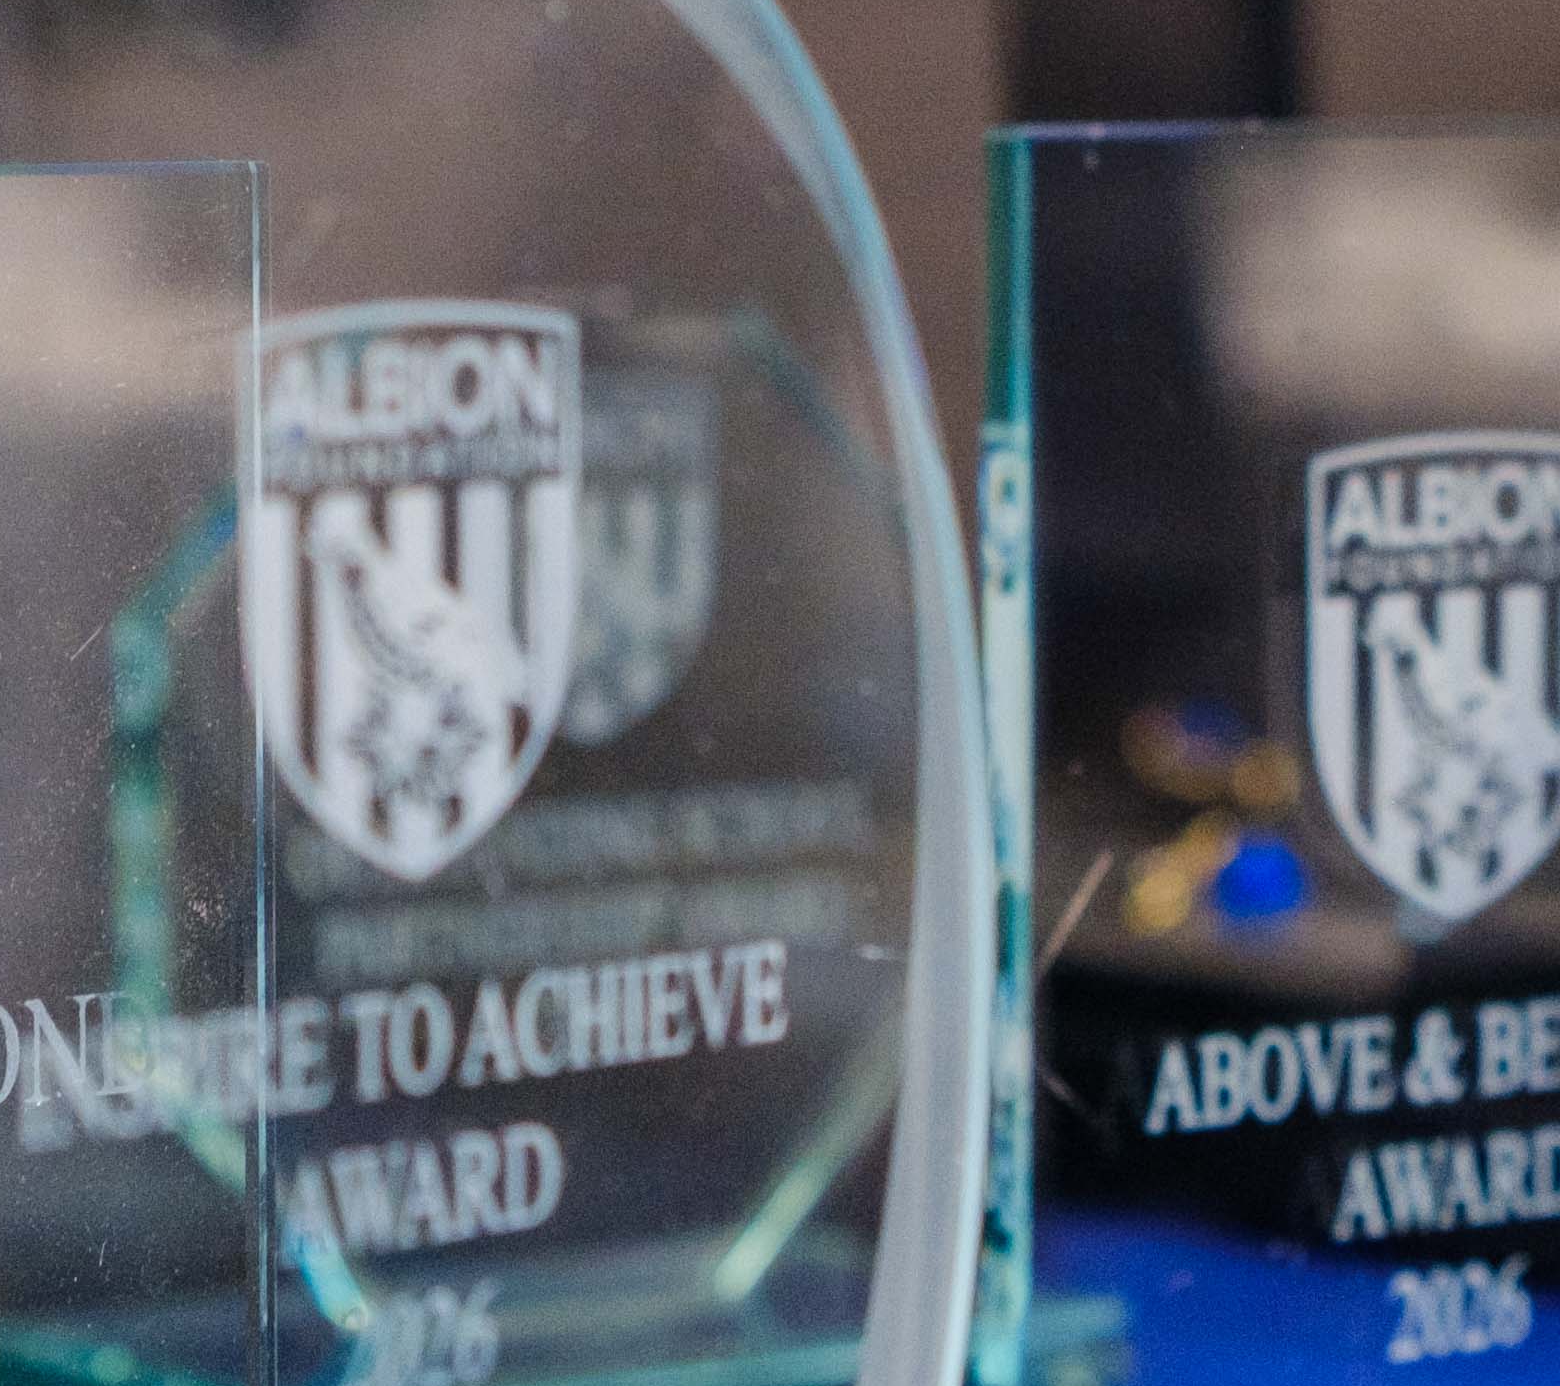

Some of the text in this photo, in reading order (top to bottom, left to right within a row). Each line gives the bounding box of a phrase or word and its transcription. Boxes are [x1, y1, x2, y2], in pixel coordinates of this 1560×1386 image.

[263, 333, 556, 441] ALBION
[343, 983, 452, 1104] TO
[458, 936, 790, 1088] ACHIEVE
[1142, 1015, 1396, 1137] ABOVE
[1402, 1006, 1468, 1108] &
